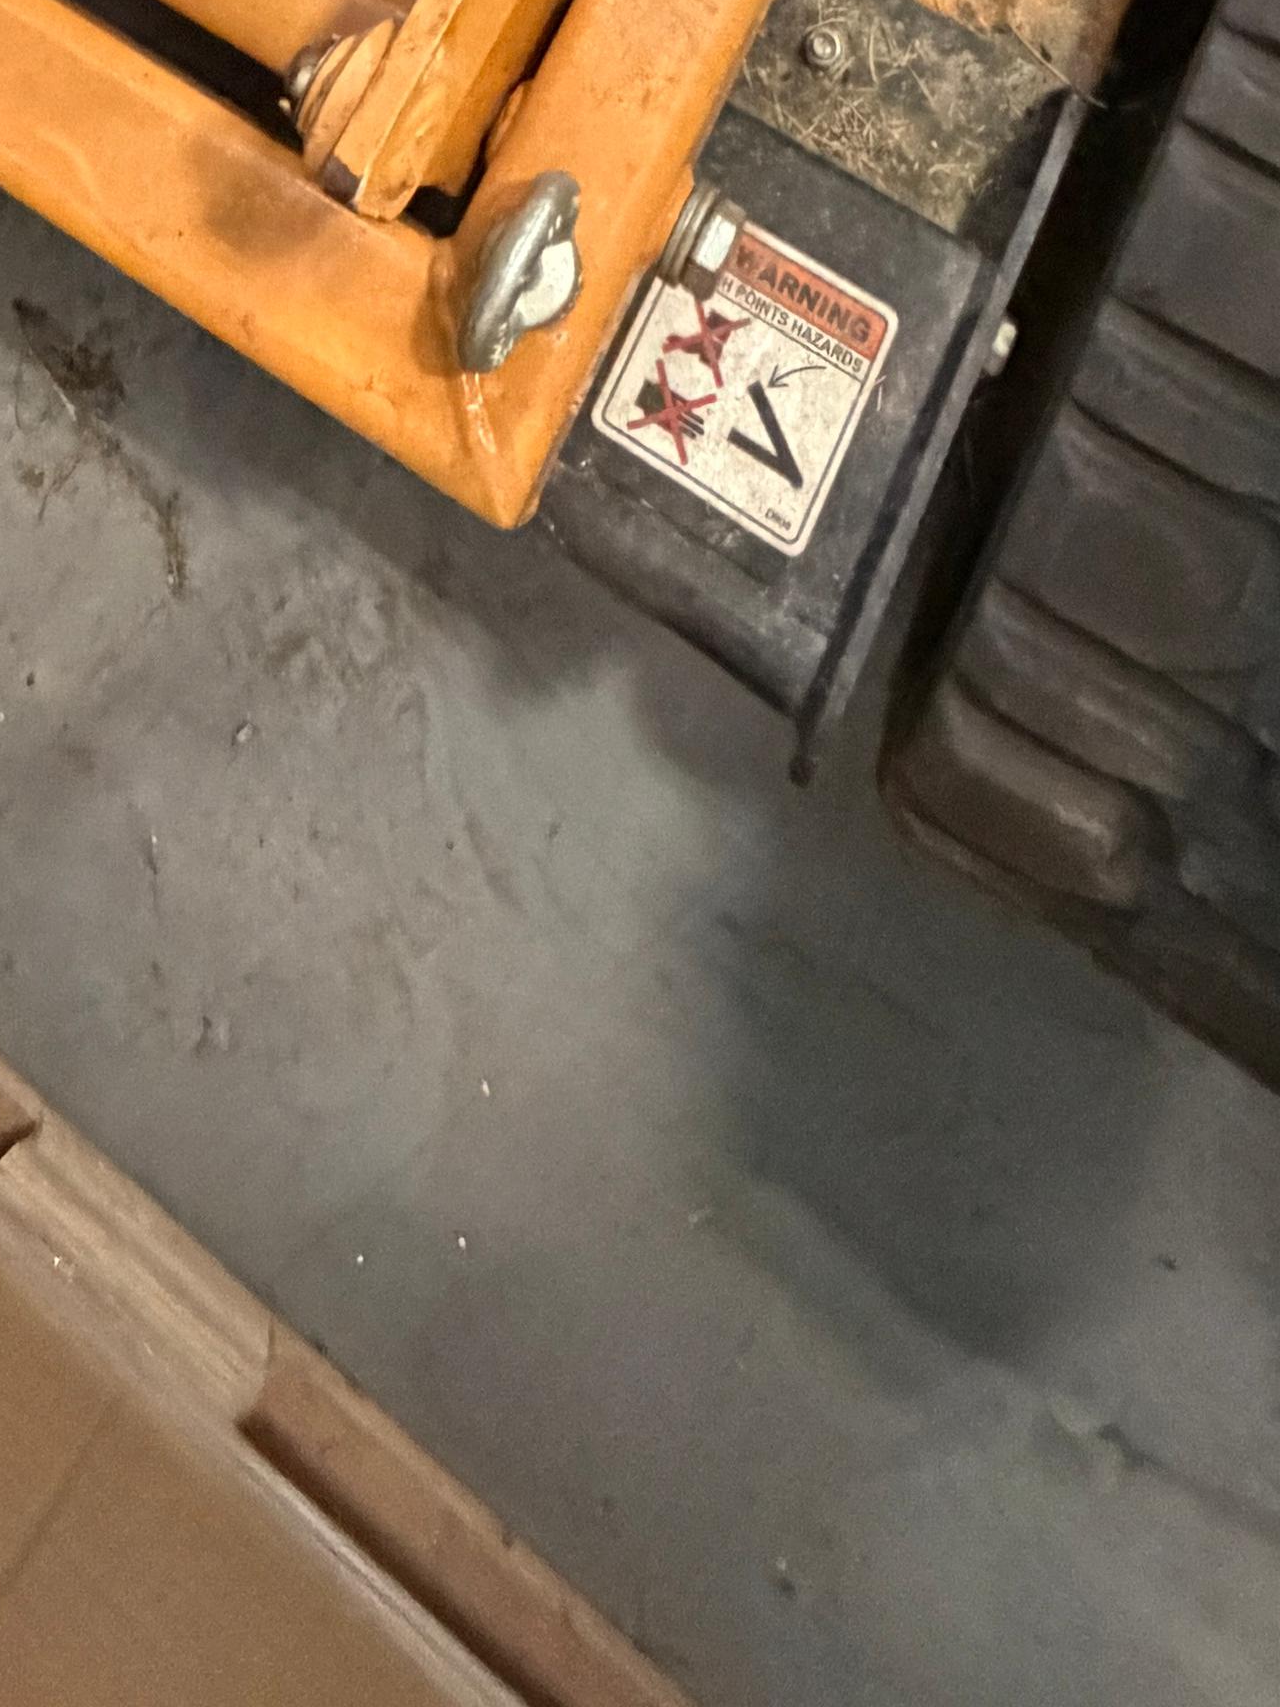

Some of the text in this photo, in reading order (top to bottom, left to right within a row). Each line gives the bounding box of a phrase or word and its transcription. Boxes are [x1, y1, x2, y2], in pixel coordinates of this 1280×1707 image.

[734, 283, 865, 375] POINTS HAZARDS
[735, 244, 872, 346] WARNING
